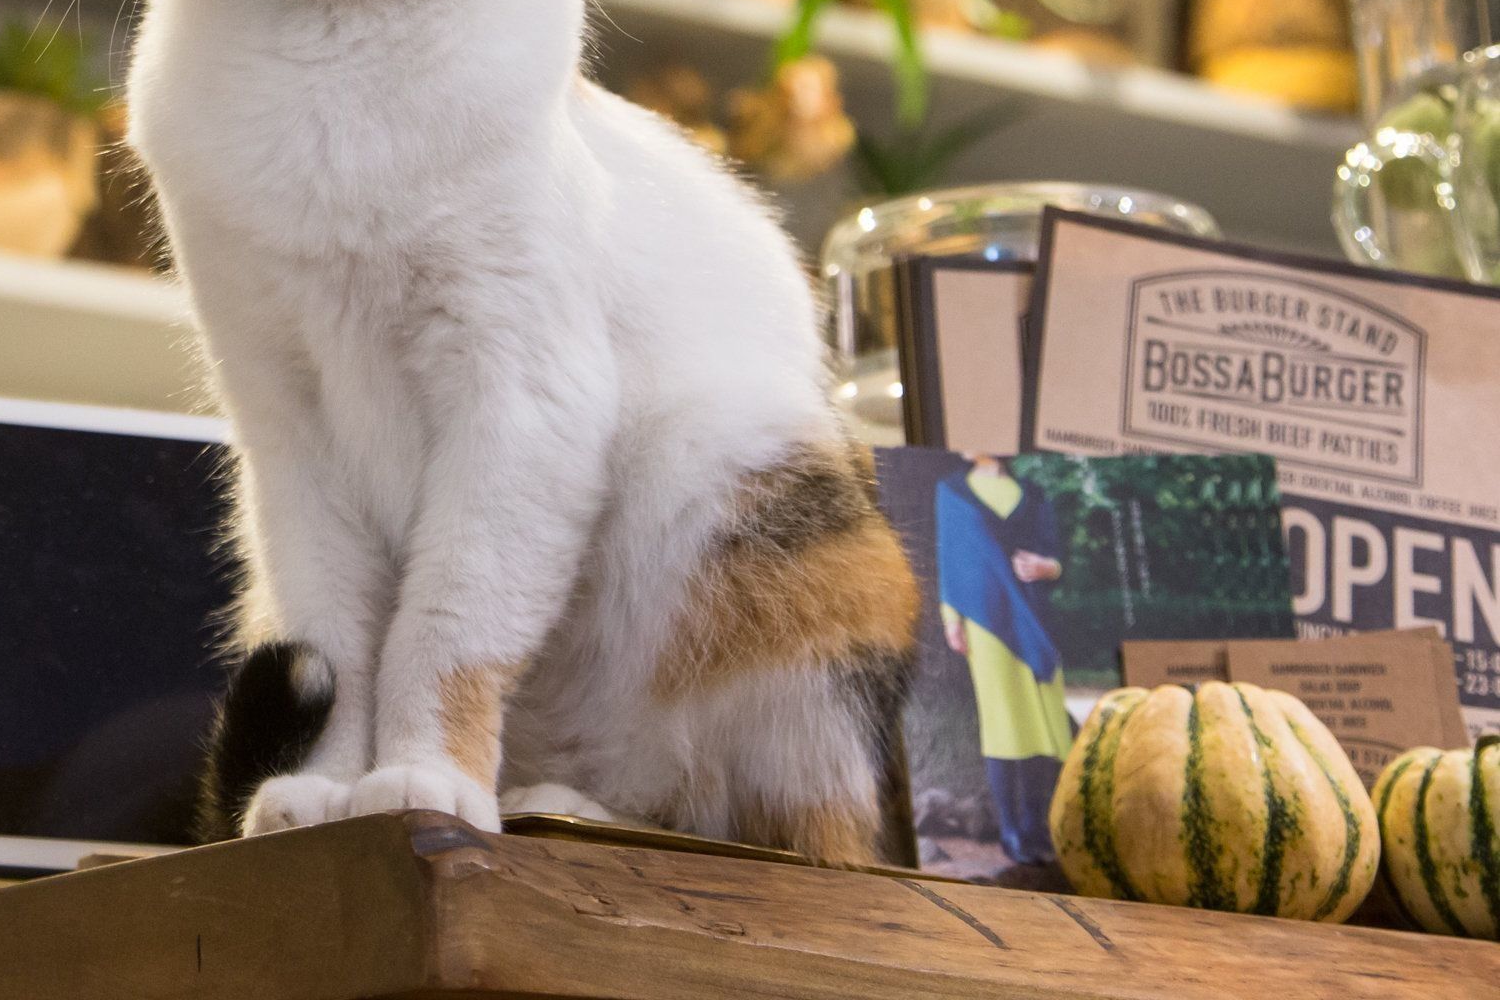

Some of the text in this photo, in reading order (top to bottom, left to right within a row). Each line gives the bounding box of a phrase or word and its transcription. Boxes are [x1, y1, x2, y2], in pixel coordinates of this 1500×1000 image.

[1158, 286, 1399, 356] THE BURGER STAND
[1148, 401, 1399, 465] 100% FRESH BEEF PATTIES
[1281, 507, 1500, 649] OPEN
